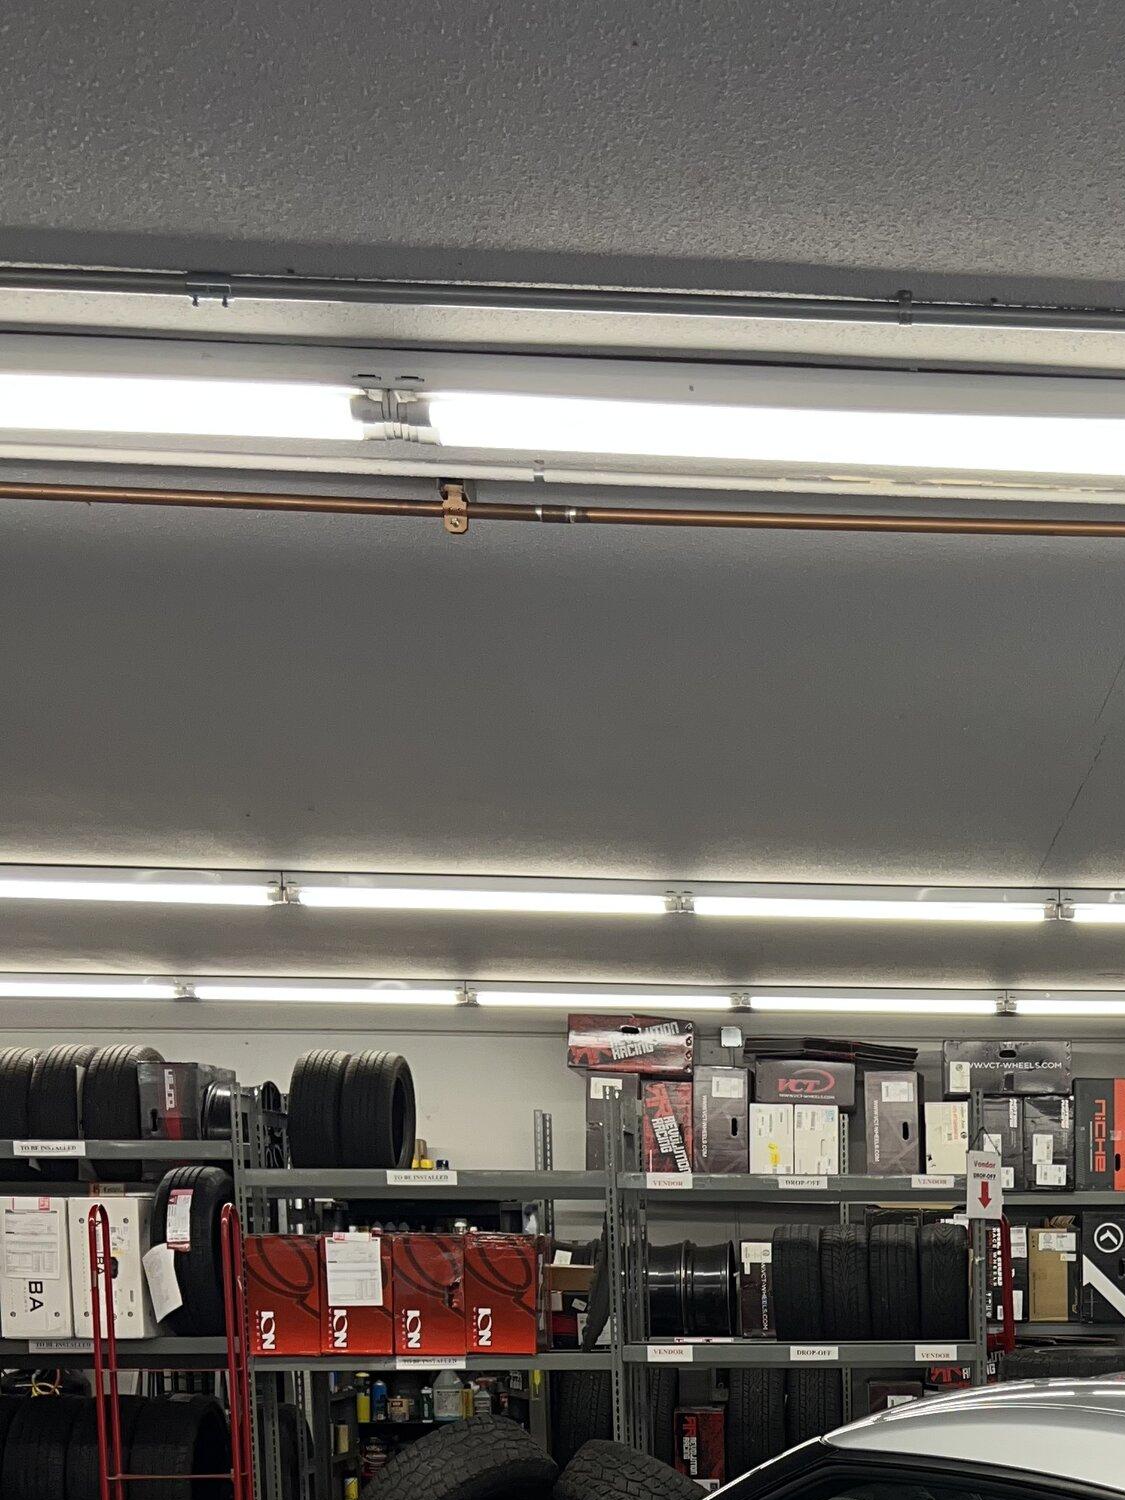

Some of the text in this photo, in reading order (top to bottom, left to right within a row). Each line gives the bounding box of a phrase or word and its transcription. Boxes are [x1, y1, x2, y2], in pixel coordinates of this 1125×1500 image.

[969, 1061, 1062, 1070] W.VCT-WHEELS.COM
[785, 1179, 821, 1187] DROP-OFF
[260, 1310, 276, 1350] ION
[332, 1309, 348, 1348] ION
[406, 1309, 421, 1349] ION
[477, 1307, 492, 1347] ION
[796, 1349, 831, 1357] DROP-OFF
